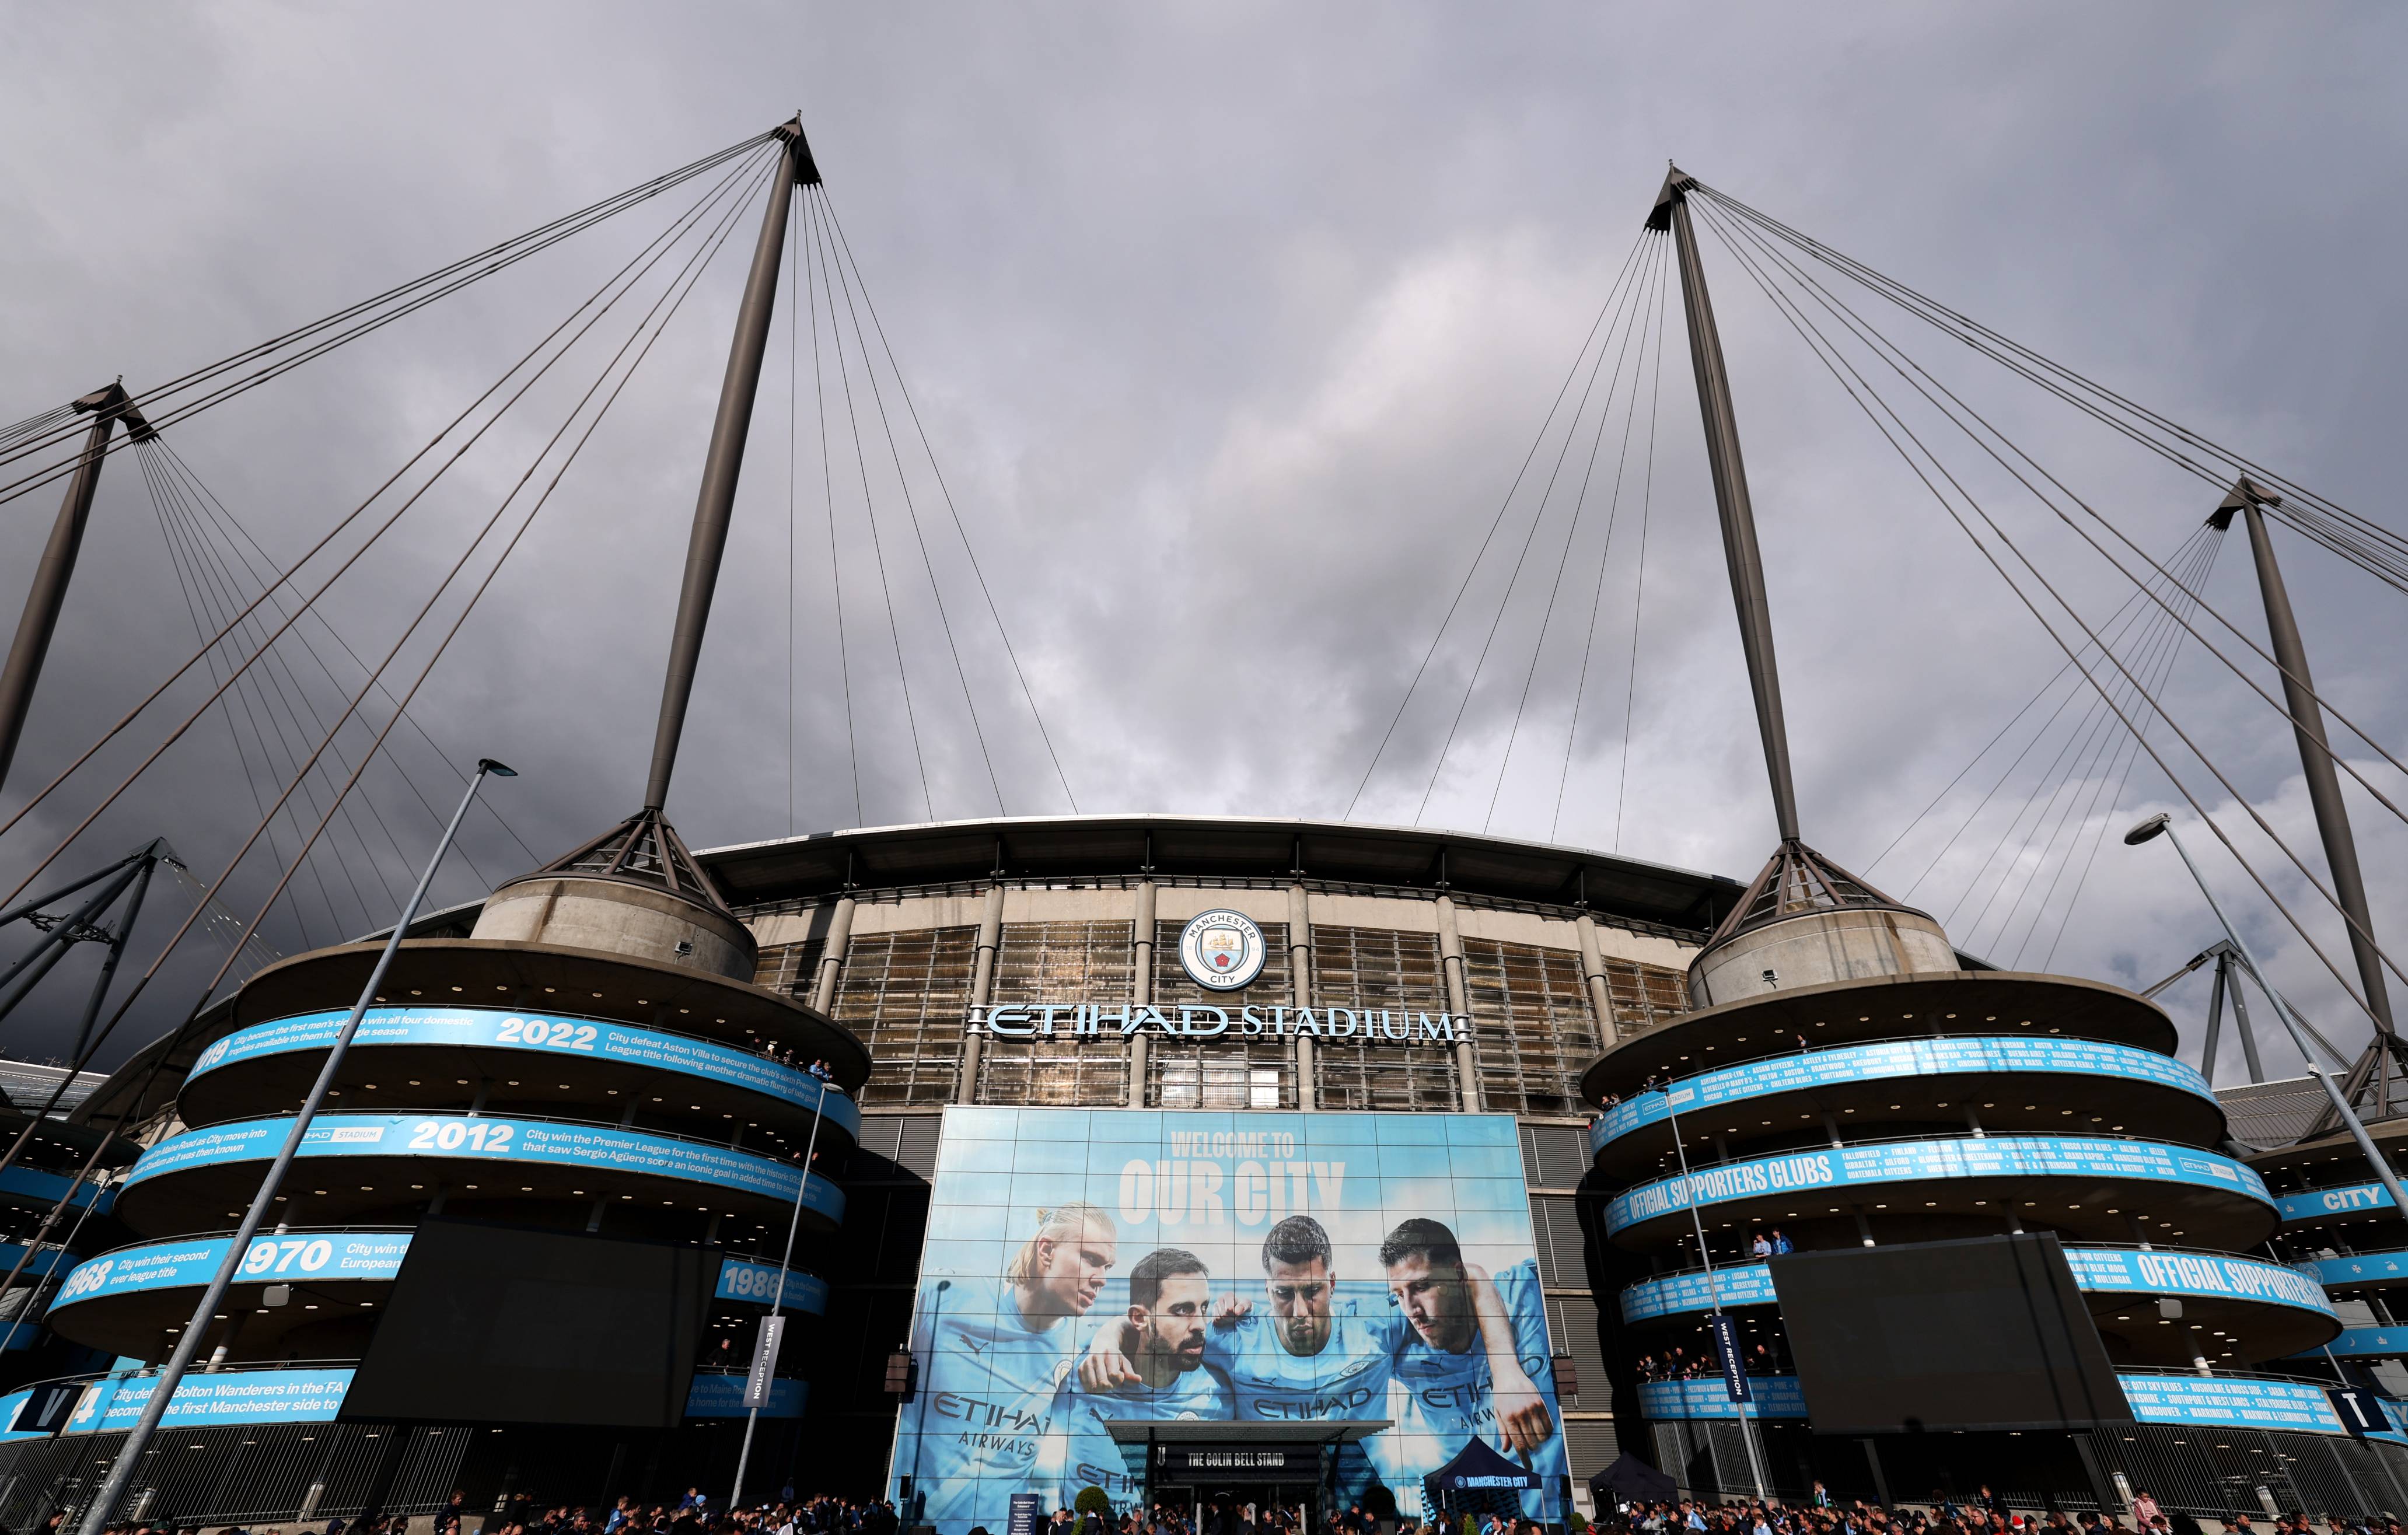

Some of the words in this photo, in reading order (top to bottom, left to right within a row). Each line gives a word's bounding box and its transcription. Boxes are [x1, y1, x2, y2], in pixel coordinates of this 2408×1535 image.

[1189, 915, 1256, 939] MANCHESTER
[276, 1025, 289, 1034] the
[289, 1023, 307, 1033] first
[307, 1020, 334, 1030] men's
[368, 1016, 387, 1025] win
[389, 1016, 401, 1024] all
[401, 1016, 424, 1025] four
[424, 1016, 474, 1026] domestic
[987, 1004, 1229, 1035] ETIHAD
[1242, 1005, 1455, 1041] STADIUM
[256, 1038, 290, 1049] available
[300, 1032, 322, 1041] them
[371, 1027, 408, 1036] season
[496, 1017, 597, 1051] 2022
[606, 1043, 641, 1056] League
[643, 1050, 662, 1060] title
[663, 1054, 704, 1069] following
[705, 1064, 736, 1076] another
[737, 1072, 769, 1086] dramatic
[770, 1080, 788, 1093] flurry
[609, 1032, 629, 1044] City
[631, 1036, 661, 1048] defeat
[662, 1042, 690, 1055] Aston
[692, 1047, 710, 1060] Villa
[721, 1057, 747, 1069] secure
[748, 1063, 760, 1072] the
[761, 1068, 780, 1079] club's
[796, 1079, 816, 1093] Premier
[1700, 1069, 1746, 1085] ASHTON-UNDER-LYNE
[1753, 1064, 1771, 1074] ASSAM
[1802, 1055, 1822, 1065] ASTLEY
[1827, 1051, 1857, 1061] TYLDESLEY
[1759, 1072, 1778, 1082] BOLTON
[1784, 1068, 1805, 1076] BOSTON
[1811, 1062, 1846, 1072] BRANTWOOD
[1853, 1058, 1882, 1067] BREDBURY
[1704, 1092, 1722, 1102] CHICAGO
[1729, 1088, 1742, 1096] CHILE
[1770, 1078, 1795, 1088] CHILTERN
[1796, 1075, 1813, 1083] BLUES
[1820, 1069, 1854, 1080] CHITTAGONG
[1862, 1065, 1895, 1075] CHONGQING
[1644, 1100, 1665, 1111] ETIHAD
[225, 1131, 248, 1141] move
[249, 1128, 267, 1138] into
[338, 1131, 378, 1139] STADIUM
[408, 1121, 514, 1152] 2012
[1170, 1131, 1267, 1158] WELCOME
[1271, 1132, 1294, 1158] TO
[196, 1146, 215, 1158] then
[215, 1144, 244, 1155] known
[526, 1129, 550, 1141] City
[551, 1132, 572, 1142] win
[574, 1134, 592, 1144] the
[593, 1136, 634, 1150] Premier
[635, 1142, 670, 1156] League
[672, 1148, 686, 1158] for
[686, 1151, 701, 1160] the
[701, 1152, 719, 1164] first
[719, 1157, 738, 1167] time
[738, 1161, 754, 1172] with
[767, 1167, 788, 1181] historic
[1841, 1149, 1880, 1160] FALLOWFIELD
[1891, 1146, 1917, 1156] FINLAND
[2022, 1142, 2050, 1150] CITYZENS
[1844, 1160, 1877, 1170] GIBRALTAR
[1885, 1157, 1910, 1166] GILFORD
[1918, 1155, 1956, 1163] GLOUCESTER
[1963, 1152, 2003, 1161] CHELTENHAM
[522, 1141, 547, 1152] that
[547, 1146, 572, 1155] saw
[573, 1146, 607, 1159] Sergio
[608, 1150, 645, 1163] Agüero
[646, 1156, 673, 1168] score
[674, 1161, 686, 1170] an
[687, 1161, 713, 1174] iconic
[713, 1168, 730, 1178] goal
[739, 1173, 761, 1185] added
[761, 1179, 775, 1189] time
[1847, 1169, 1882, 1179] GUATEMALA
[1884, 1167, 1913, 1176] CITYZENS
[2183, 1162, 2210, 1172] ETIHAD
[1119, 1159, 1225, 1225] OUR
[1235, 1160, 1345, 1226] CITY
[1629, 1185, 1672, 1220] OFFICIAL
[1670, 1163, 1767, 1207] SUPPORTERS
[1769, 1155, 1833, 1188] CLUBS
[2323, 1187, 2379, 1210] CITY
[118, 1260, 134, 1271] City
[134, 1257, 152, 1268] win
[151, 1253, 173, 1265] their
[172, 1249, 210, 1263] second
[347, 1243, 373, 1255] City
[374, 1243, 397, 1254] win
[2094, 1252, 2123, 1262] CITYZENS
[340, 1258, 401, 1270] European
[2090, 1264, 2106, 1272] BLUE
[2107, 1264, 2127, 1273] MOON
[60, 1260, 114, 1301] 1968
[110, 1274, 128, 1285] ever
[128, 1270, 158, 1282] league
[158, 1267, 177, 1278] title
[725, 1267, 781, 1299] 1986
[1731, 1271, 1749, 1280] LUSAKA
[1732, 1280, 1761, 1290] MERSEYSIDE
[2095, 1274, 2132, 1284] MULLINGAR
[2137, 1254, 2232, 1292] OFFICIAL
[2224, 1261, 2319, 1307] SUPPORTERS
[766, 1323, 775, 1348] WEST
[1721, 1322, 1731, 1346] WEST
[1726, 1347, 1742, 1395] RECEPTION
[753, 1349, 769, 1399] RECEPTION
[112, 1386, 134, 1401] City
[214, 1383, 285, 1397] Wanderers
[286, 1382, 299, 1394] in
[302, 1382, 324, 1394] the
[326, 1382, 343, 1393] FA
[2131, 1381, 2148, 1391] CITY
[2147, 1381, 2162, 1391] SKY
[2161, 1382, 2183, 1392] BLUES
[2190, 1383, 2225, 1394] RUSHOLME
[2230, 1384, 2249, 1394] MOSS
[2249, 1386, 2263, 1396] SIDE
[2267, 1386, 2287, 1397] SABAH
[36, 1389, 71, 1426] V
[181, 1401, 208, 1414] first
[209, 1400, 291, 1413] Manchester
[292, 1398, 321, 1411] side
[323, 1399, 337, 1410] to
[1253, 1387, 1371, 1419] ETIHAD
[2167, 1394, 2206, 1405] SOUTHPORT
[2211, 1396, 2231, 1407] WEST
[2231, 1397, 2250, 1407] LANCS
[2255, 1398, 2293, 1410] STALYBRIDGE
[2341, 1393, 2369, 1427] T
[2139, 1405, 2182, 1417] VANCOUVER
[2189, 1407, 2234, 1419] WARRINGTON
[2241, 1410, 2273, 1421] WARWICK
[2277, 1412, 2312, 1423] LEAMINGTON
[958, 1431, 1035, 1456] AIRWAYS
[1157, 1446, 1166, 1466] U
[1188, 1453, 1204, 1466] THE
[1206, 1453, 1232, 1466] COLIN
[1235, 1453, 1255, 1466] BELL
[1257, 1453, 1284, 1466] STAND
[1466, 1476, 1512, 1487] MANCHESTER
[1513, 1477, 1528, 1487] CITY
